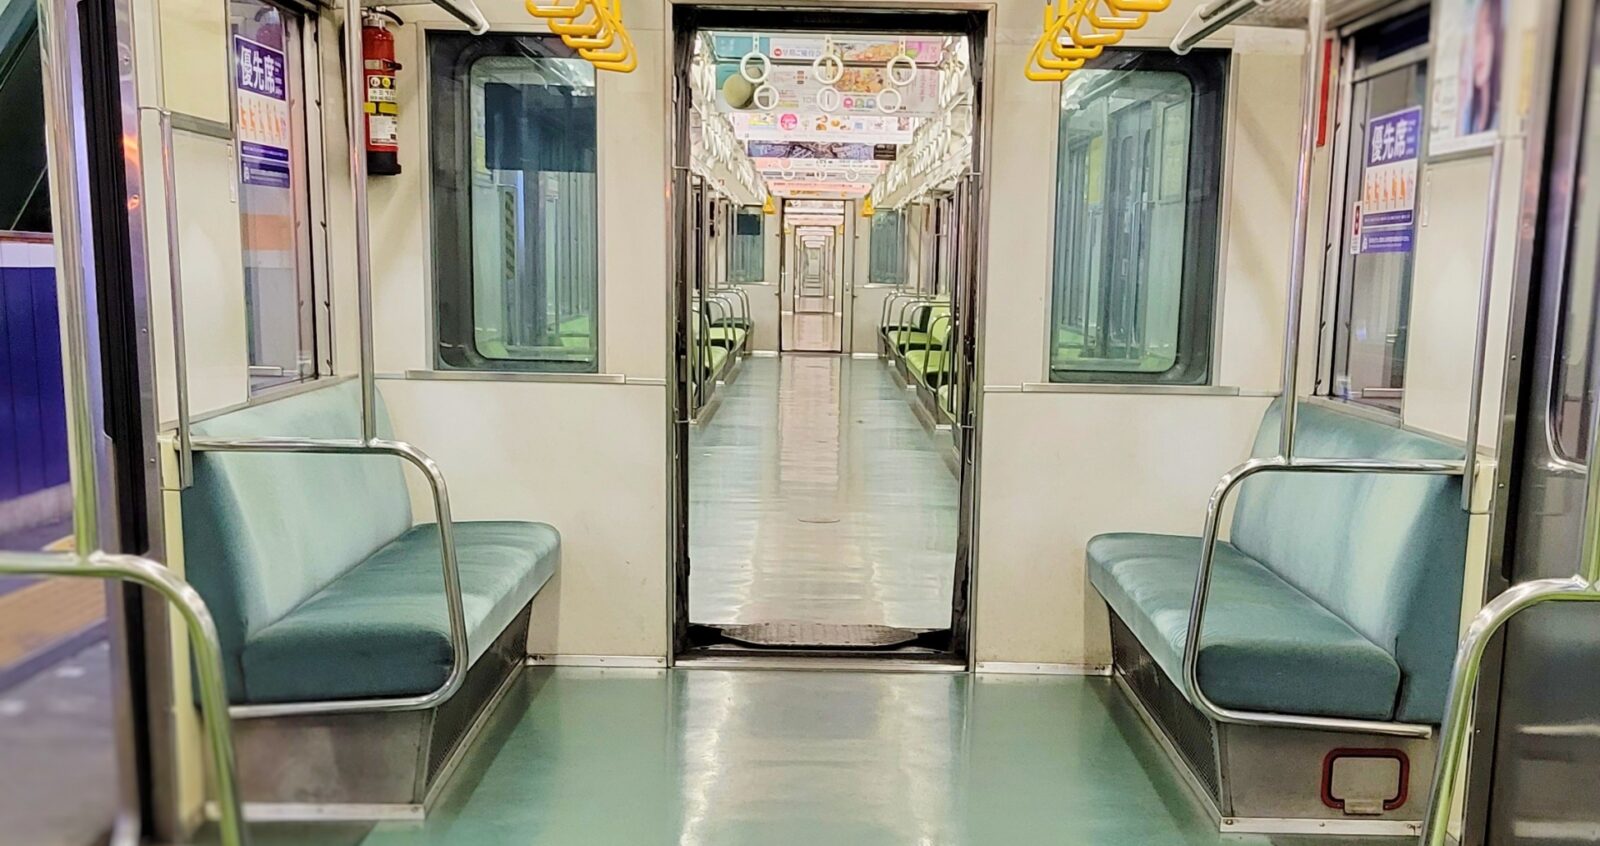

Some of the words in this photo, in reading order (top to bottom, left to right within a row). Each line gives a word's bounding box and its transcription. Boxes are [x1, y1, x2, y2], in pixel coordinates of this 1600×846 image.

[241, 46, 275, 94] 優先席
[1372, 120, 1407, 163] 優先席
